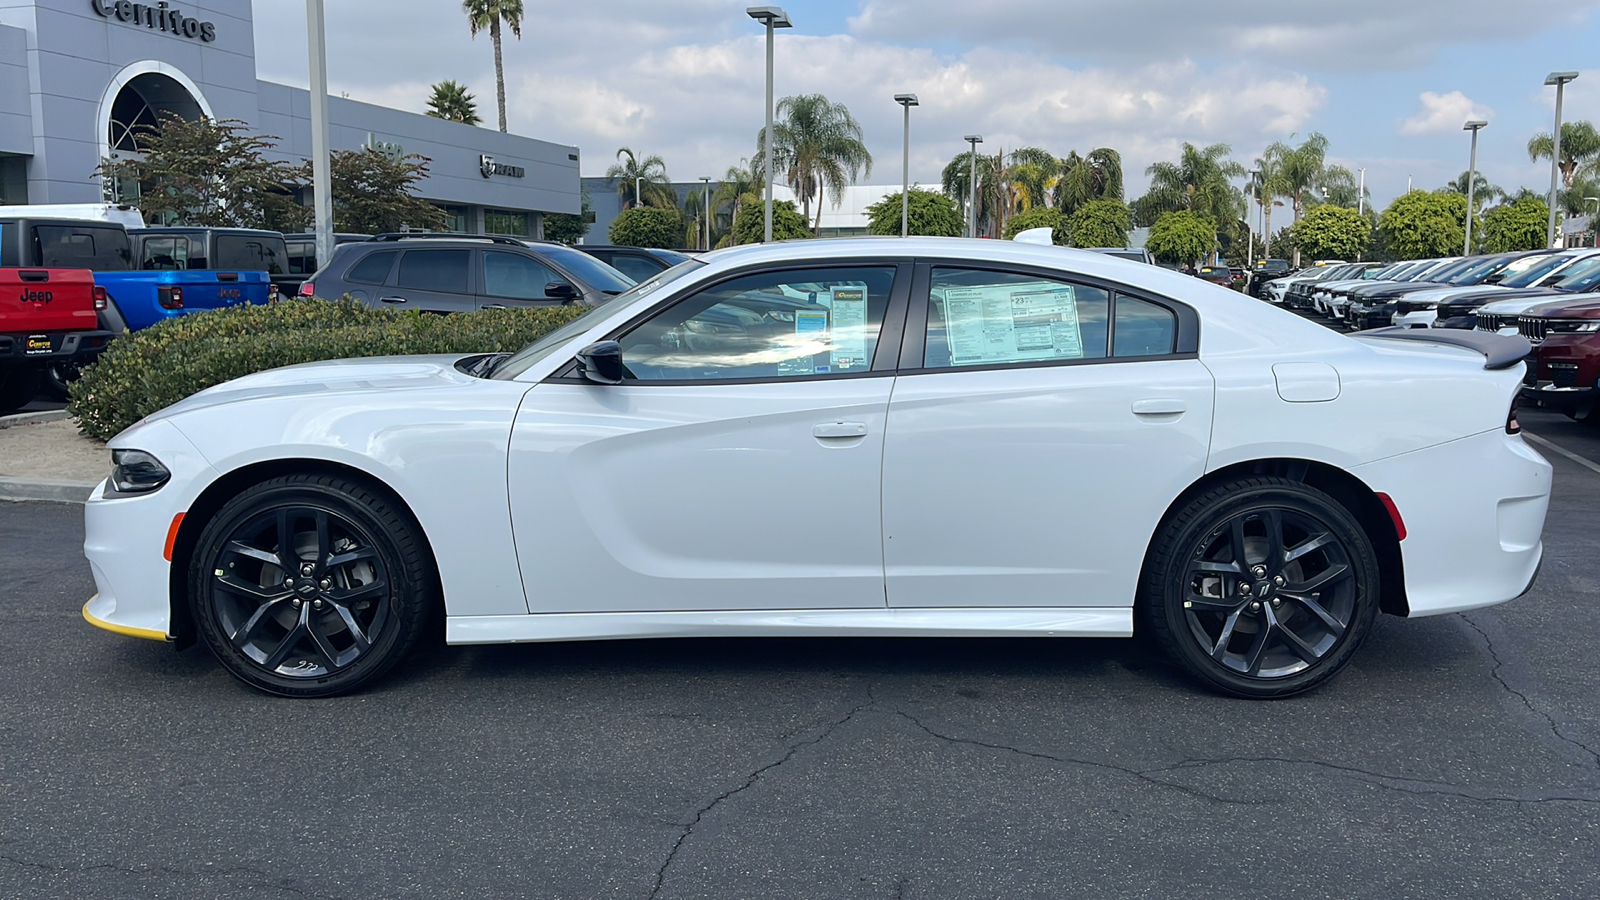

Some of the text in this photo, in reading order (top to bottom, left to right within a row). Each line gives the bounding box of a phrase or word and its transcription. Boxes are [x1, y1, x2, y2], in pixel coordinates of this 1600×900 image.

[92, 0, 216, 42] Cerritos
[494, 162, 525, 178] RAM
[20, 287, 53, 305] Jeep
[217, 286, 241, 300] Jeep
